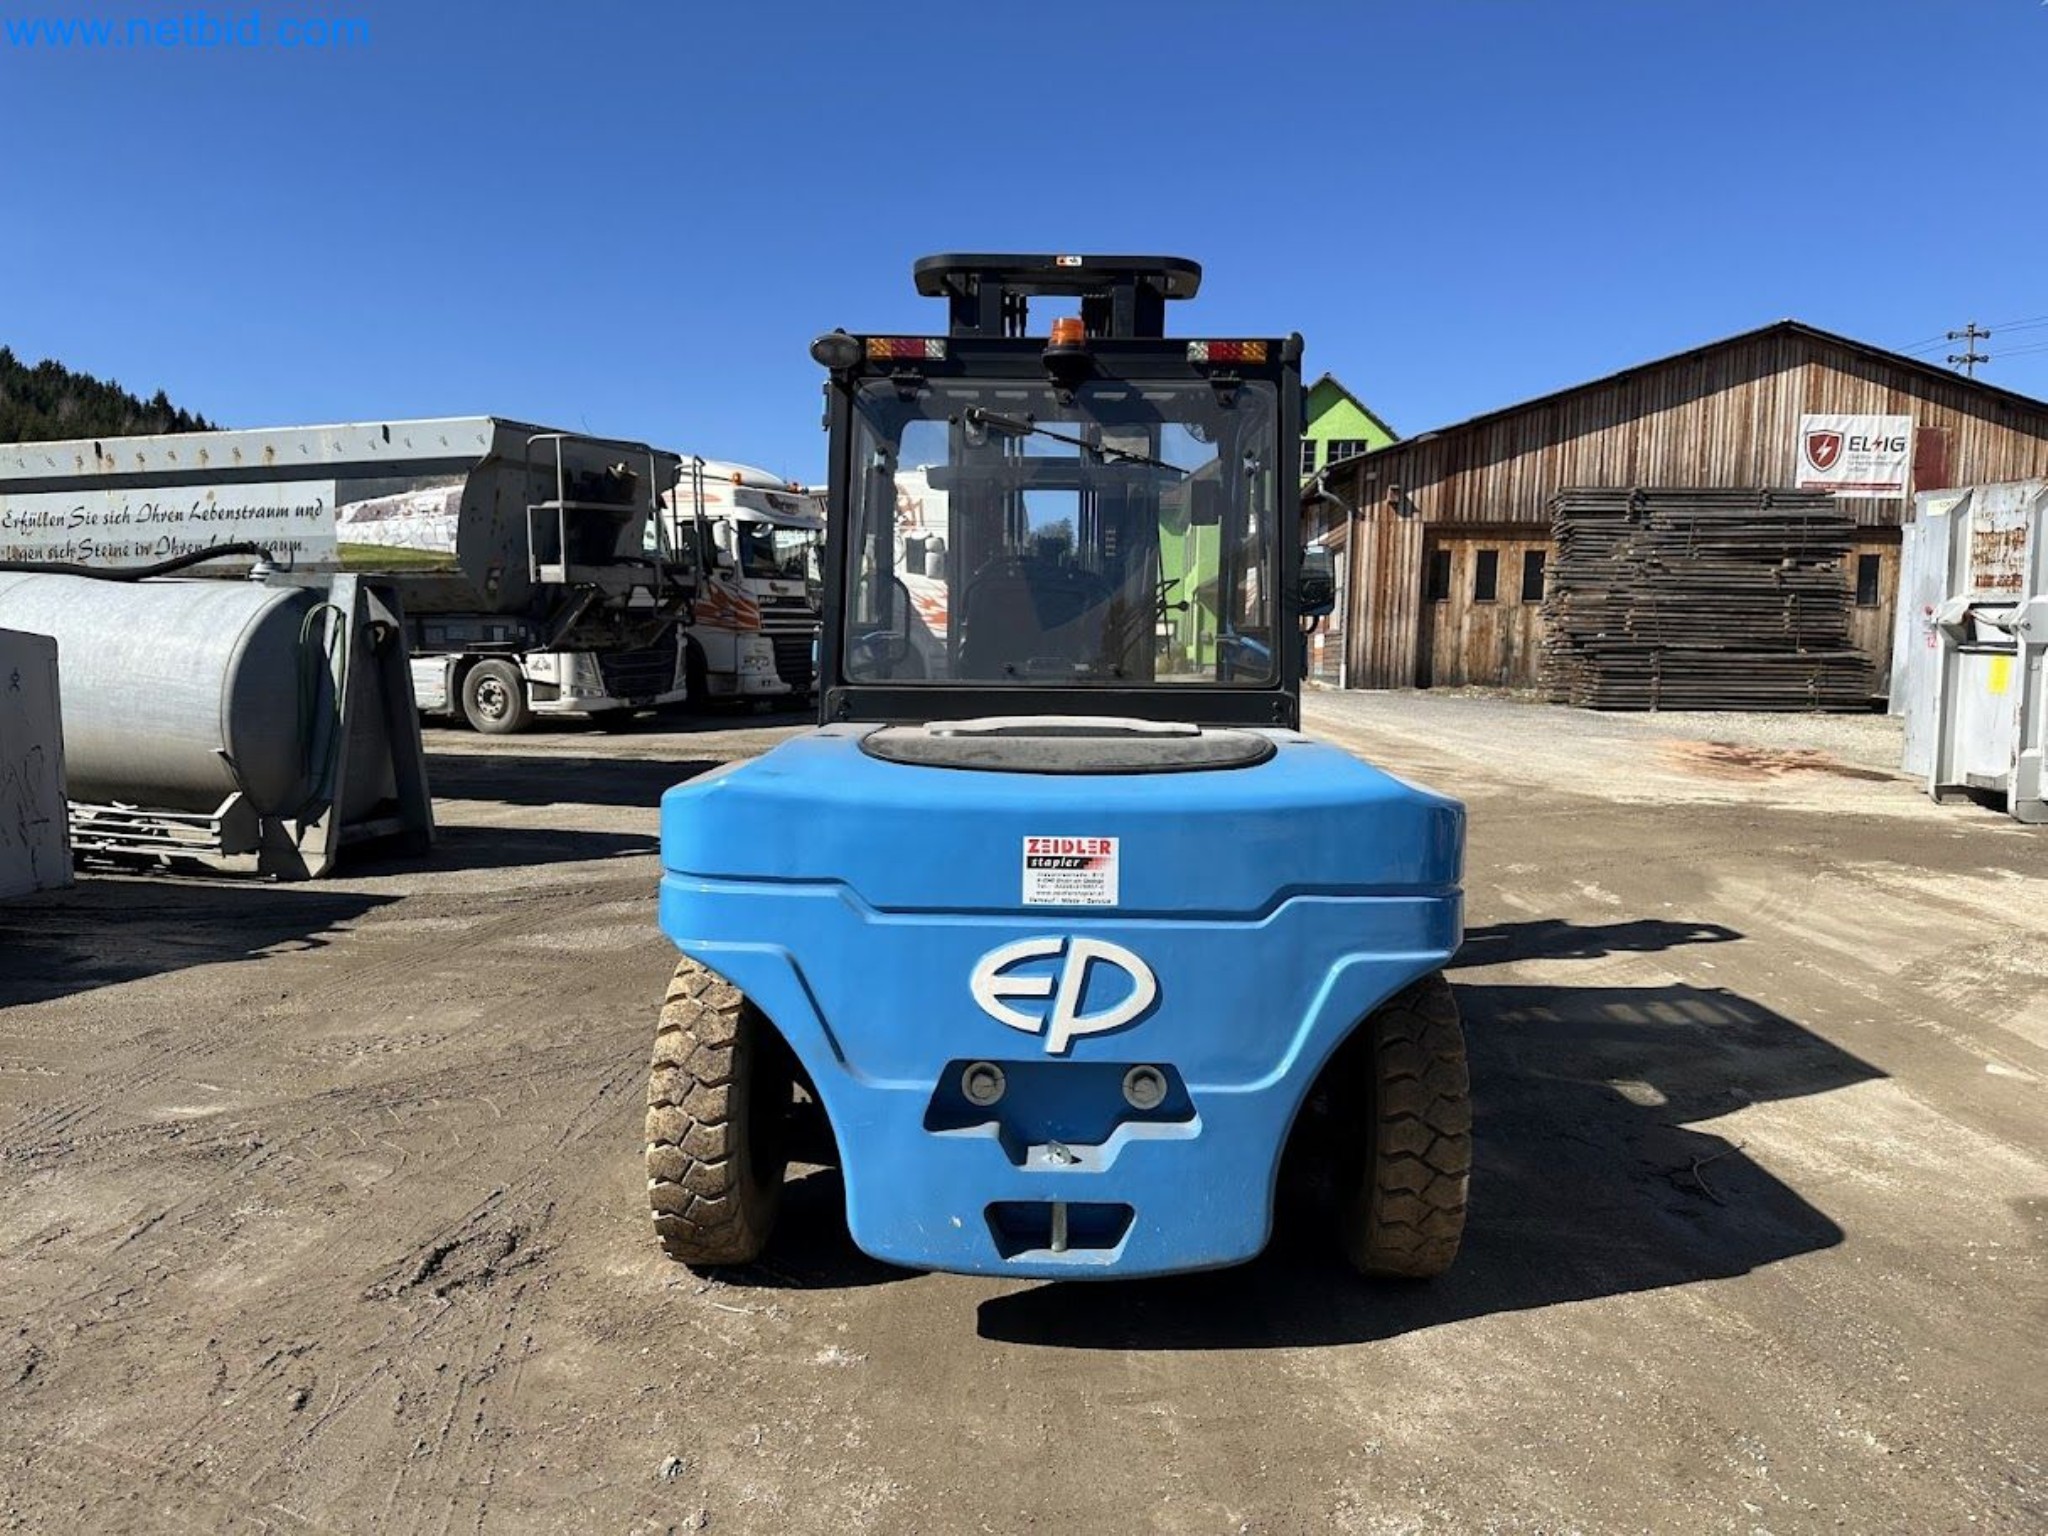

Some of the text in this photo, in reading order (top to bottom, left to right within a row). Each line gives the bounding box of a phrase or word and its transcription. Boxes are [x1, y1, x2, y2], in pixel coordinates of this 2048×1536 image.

[2, 498, 323, 536] Erfüllen Sie sich Ihren Lebenstraum und
[48, 539, 74, 560] sich
[77, 538, 128, 560] Steine
[1028, 839, 1111, 854] ZEIDLER
[1031, 857, 1079, 868] stapler
[971, 936, 1157, 1053] EP
